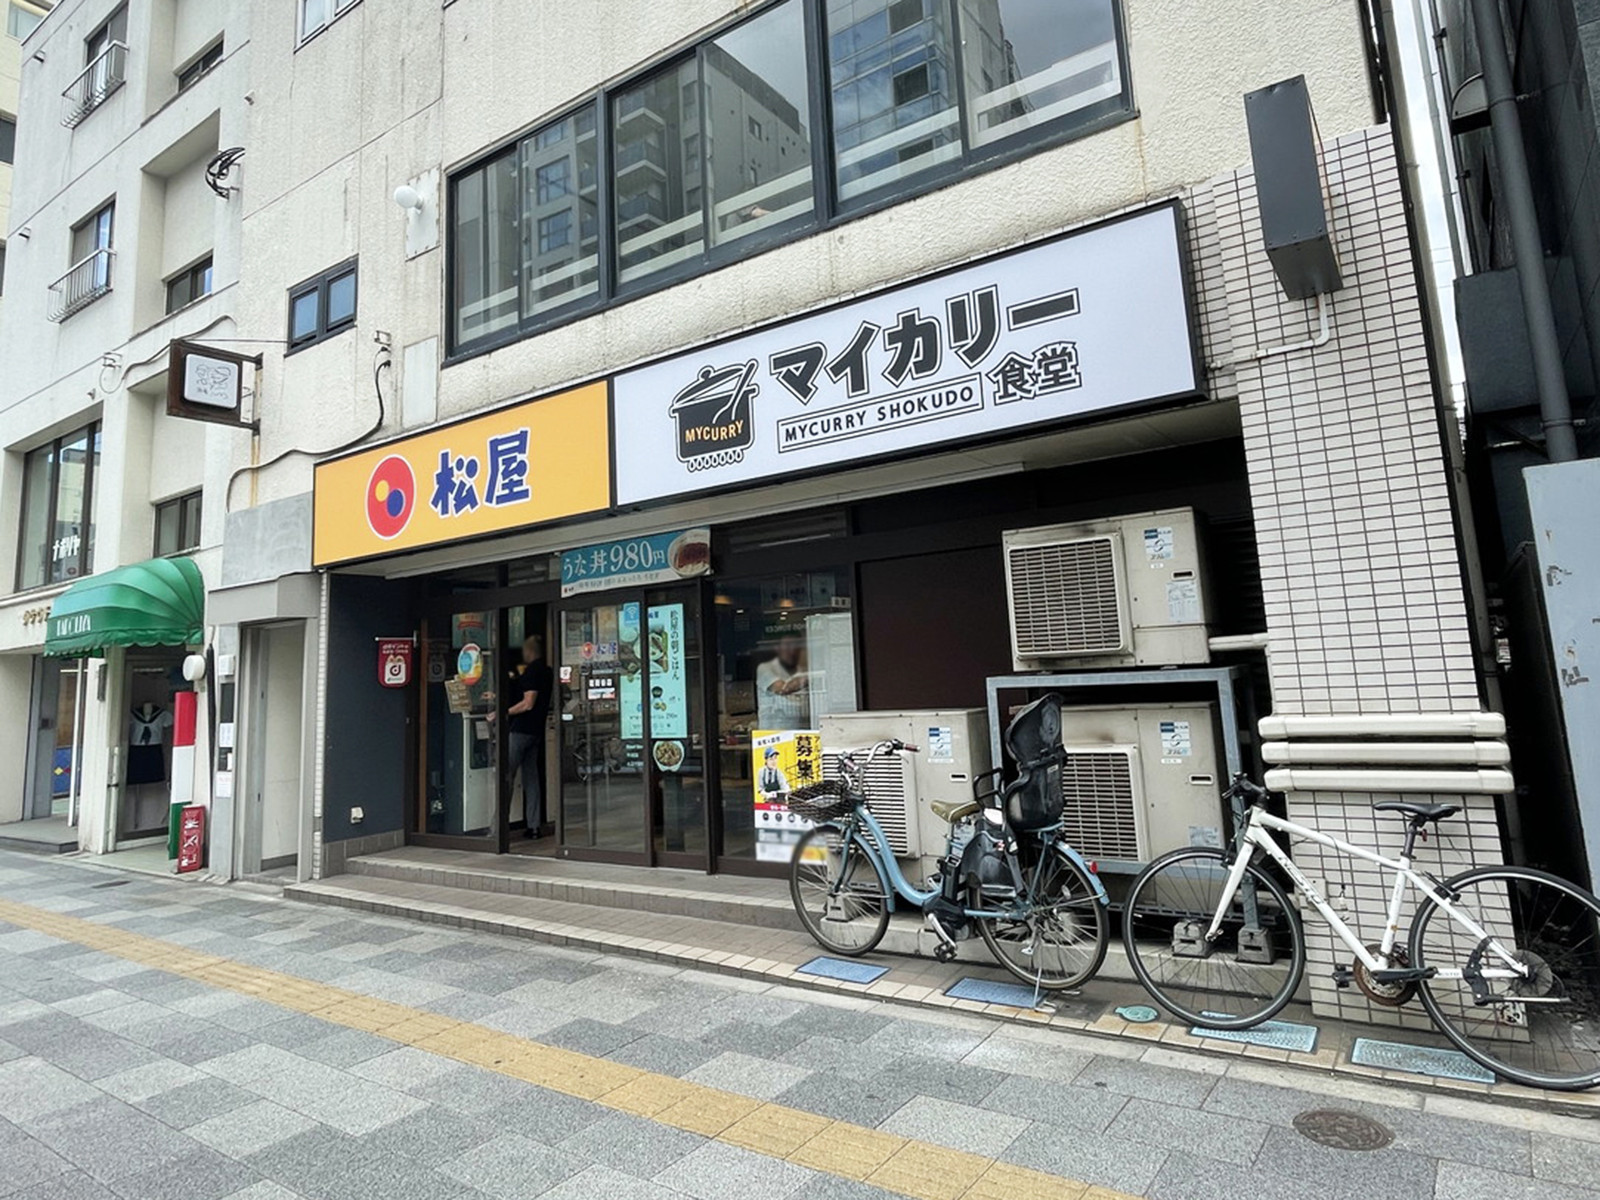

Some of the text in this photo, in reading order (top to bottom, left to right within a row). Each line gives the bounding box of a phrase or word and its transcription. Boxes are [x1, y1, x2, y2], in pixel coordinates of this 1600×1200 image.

[769, 284, 1081, 406] マイカリー
[986, 342, 1082, 406] 食堂
[684, 419, 744, 444] MYCURRY
[784, 386, 974, 443] MYCURRY SHOKUDO
[430, 428, 532, 519] 松屋
[795, 735, 814, 780] 募集
